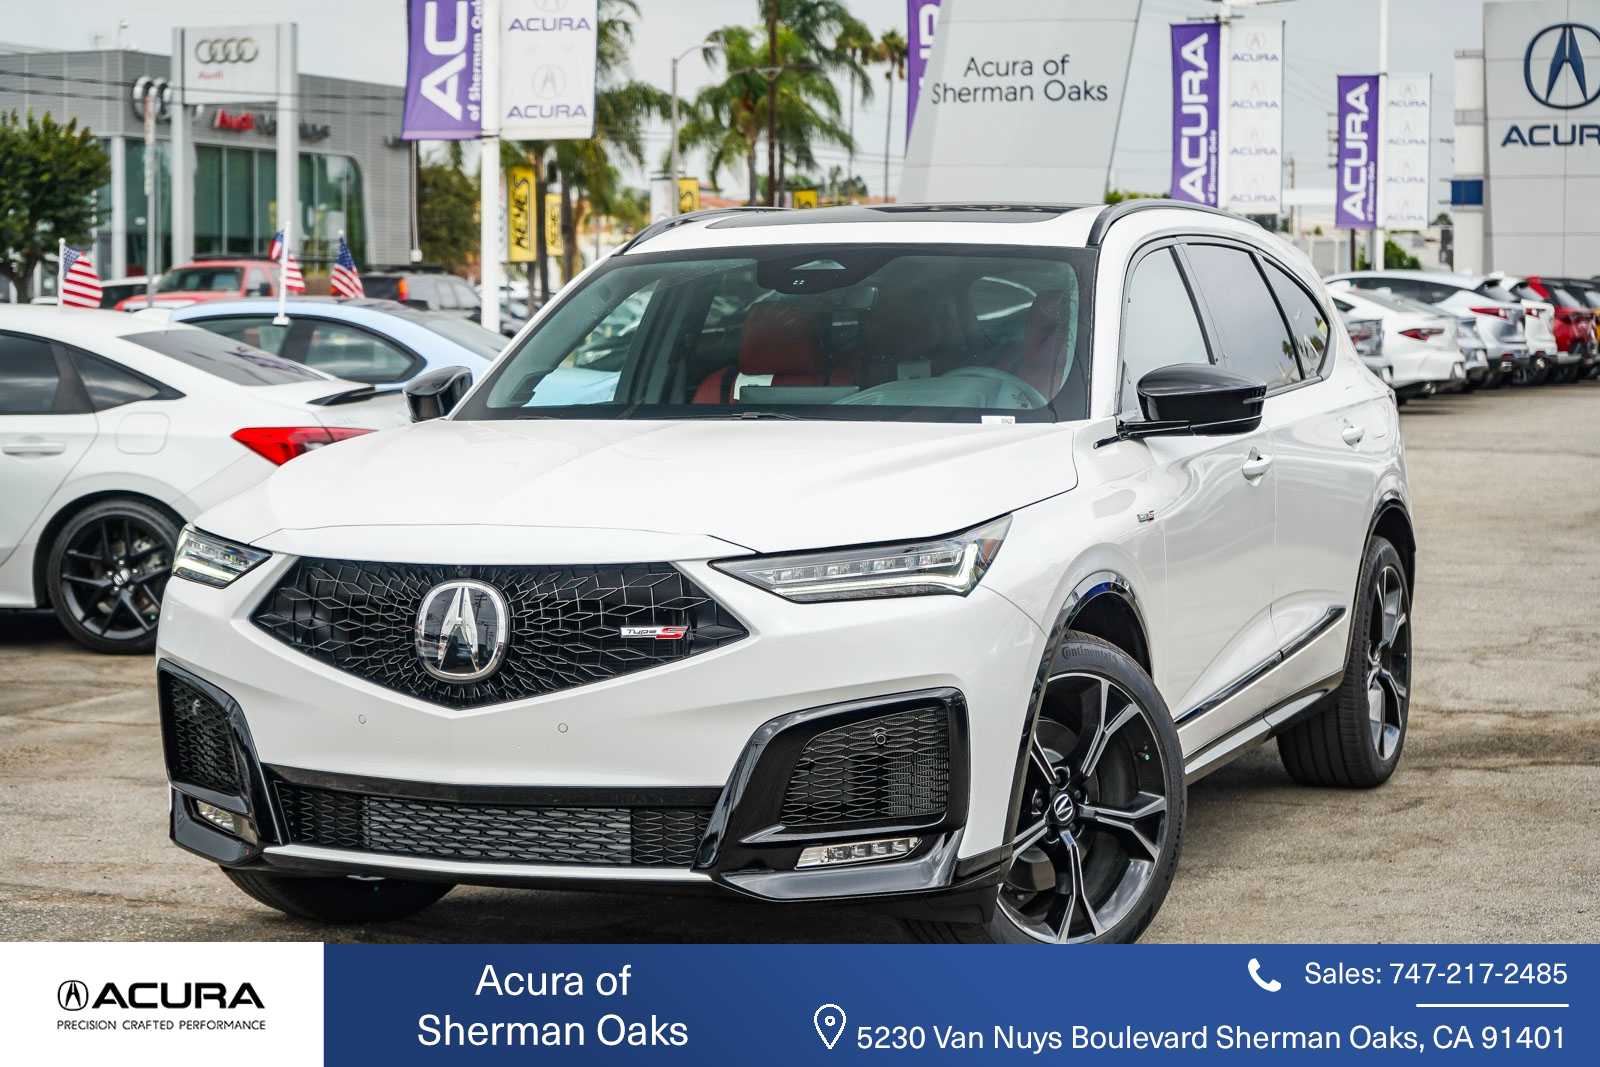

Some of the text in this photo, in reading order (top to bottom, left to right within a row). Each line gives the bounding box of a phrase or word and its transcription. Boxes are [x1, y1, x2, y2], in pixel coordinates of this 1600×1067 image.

[508, 17, 591, 32] ACURA
[963, 54, 1070, 77] Acura of
[1232, 53, 1279, 62] ACURA
[931, 80, 1109, 104] Sherman Oaks
[507, 104, 588, 119] ACURA
[1180, 32, 1208, 203] ACURA
[1342, 82, 1370, 221] ACURA
[655, 626, 689, 640] S
